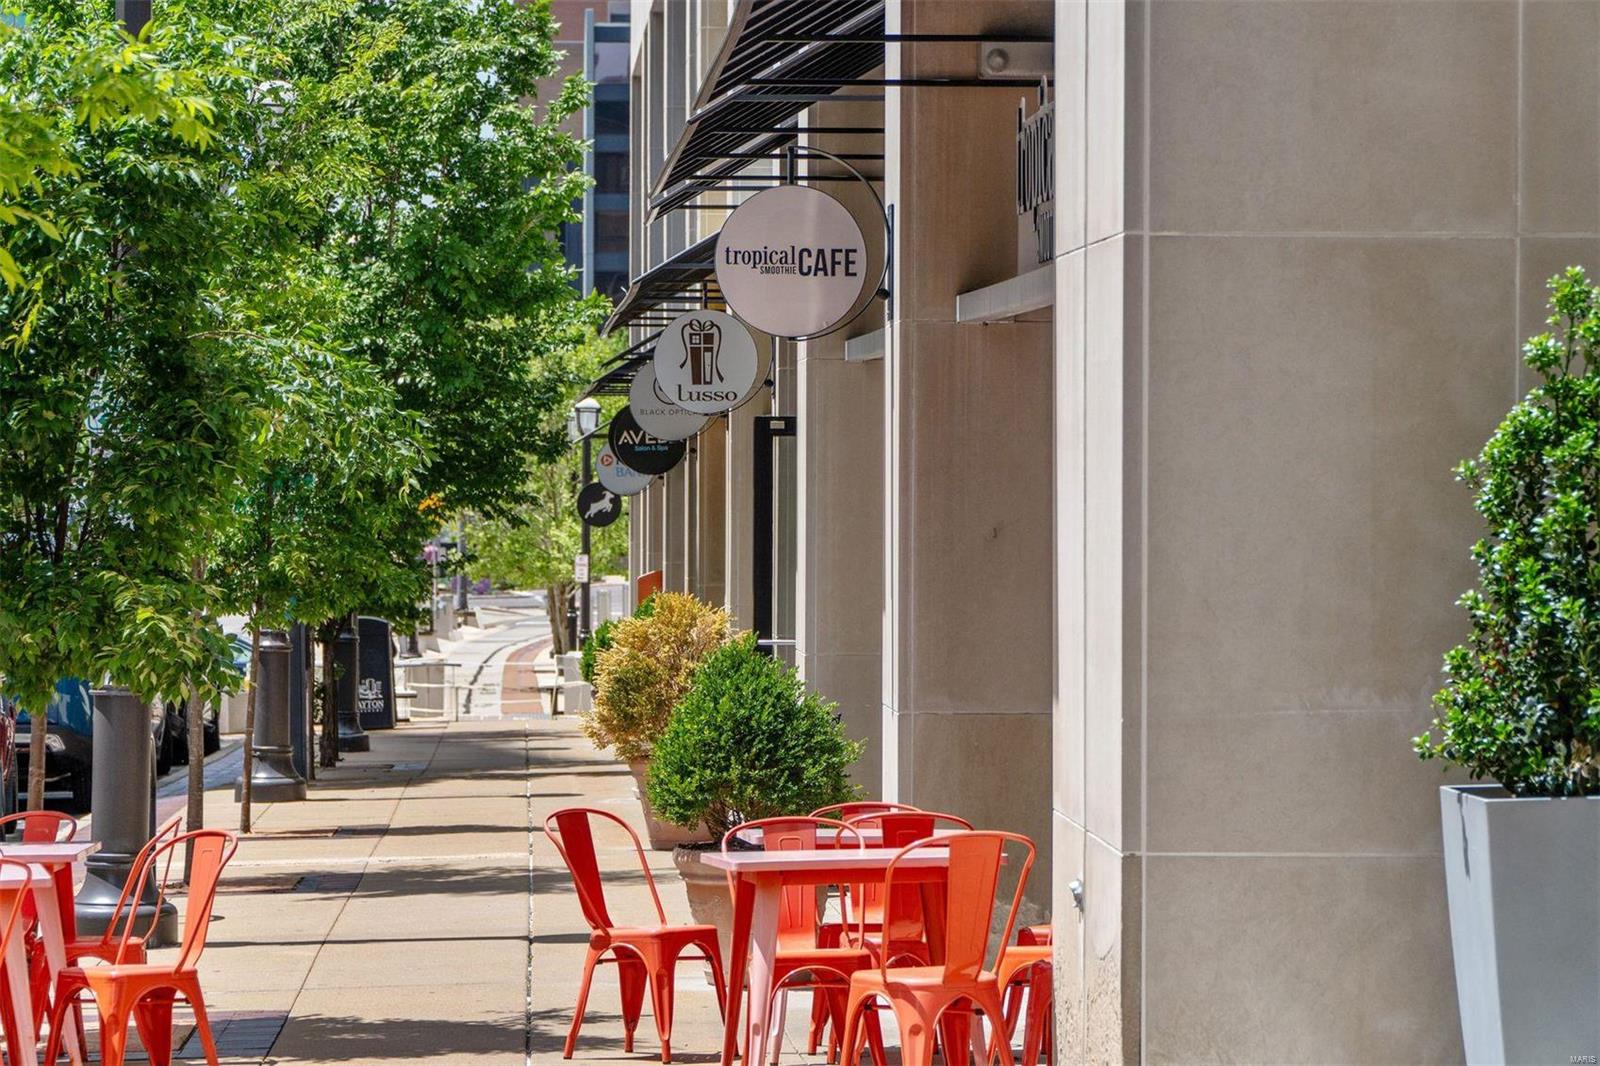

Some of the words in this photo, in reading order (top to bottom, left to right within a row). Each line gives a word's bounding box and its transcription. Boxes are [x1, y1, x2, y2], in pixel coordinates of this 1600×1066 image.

[725, 245, 797, 269] tropical
[798, 247, 857, 277] CAFE
[760, 266, 797, 275] SMOOTHIE
[640, 408, 666, 416] BLACK
[617, 430, 676, 445] AVE
